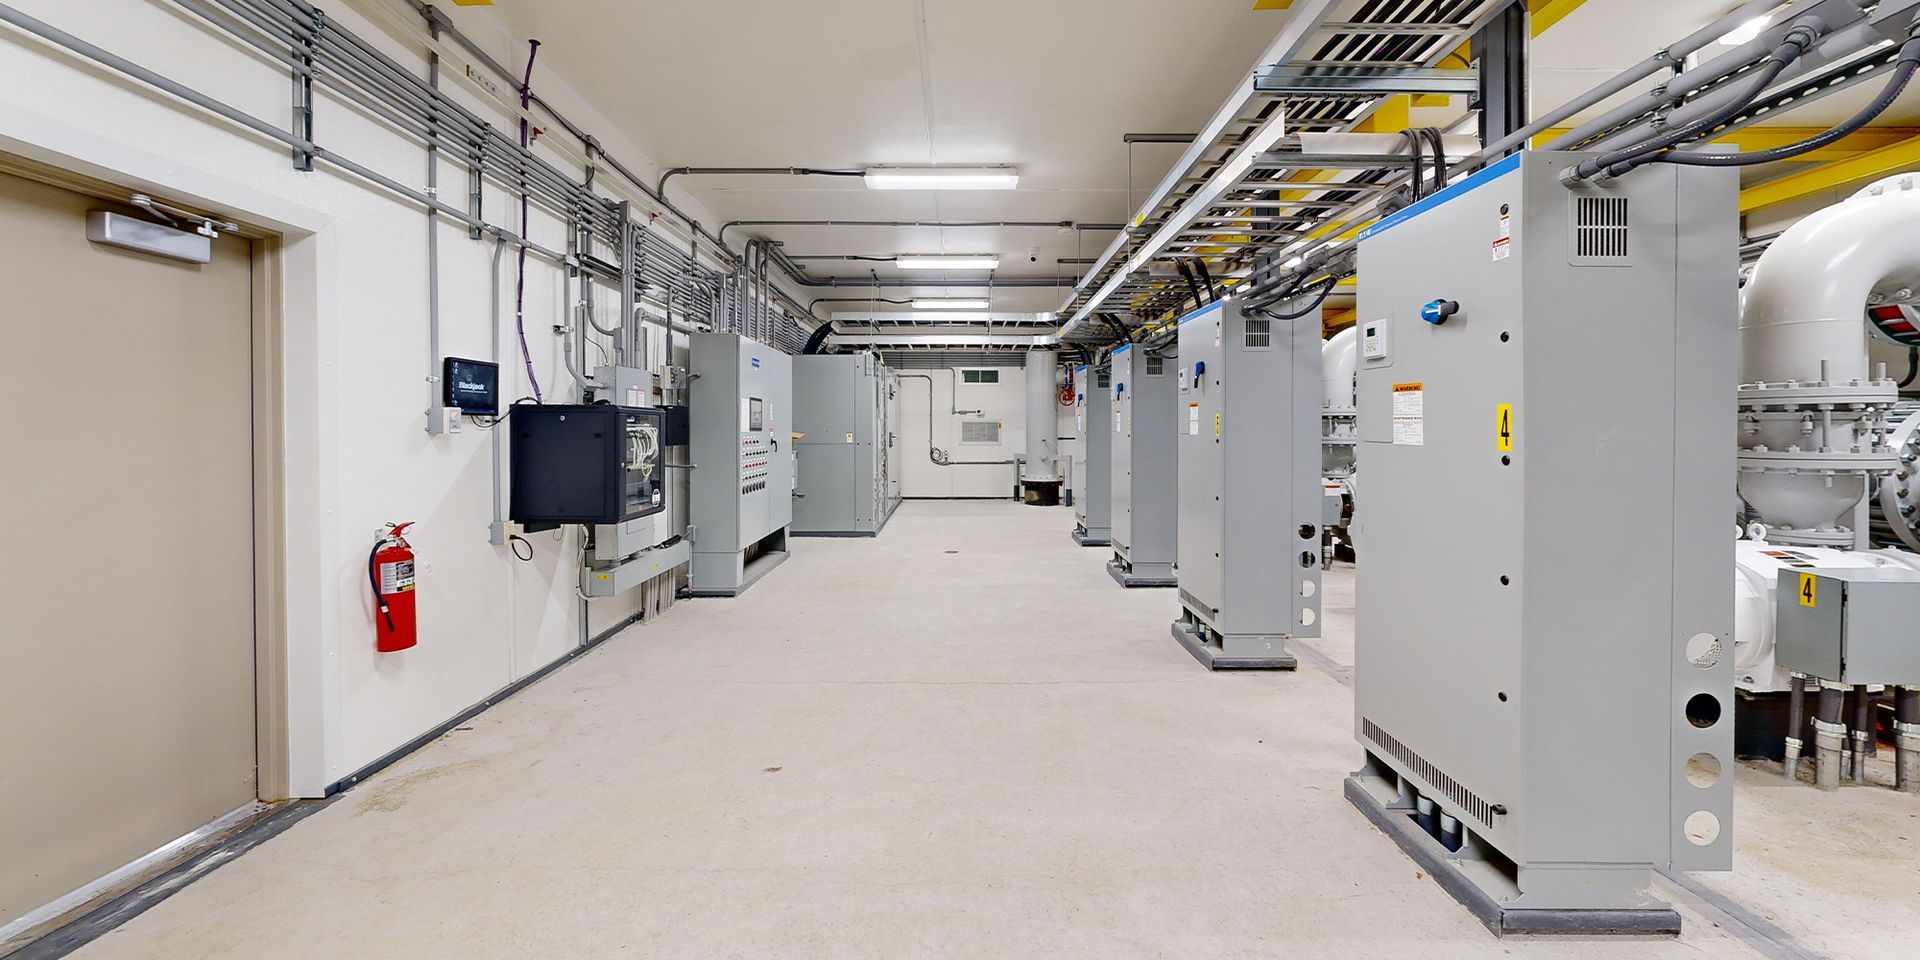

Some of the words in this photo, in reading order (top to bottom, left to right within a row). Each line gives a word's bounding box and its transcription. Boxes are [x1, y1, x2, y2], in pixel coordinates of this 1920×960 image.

[458, 381, 485, 391] Blackjack
[1500, 409, 1510, 446] 4
[1803, 577, 1812, 603] 4
